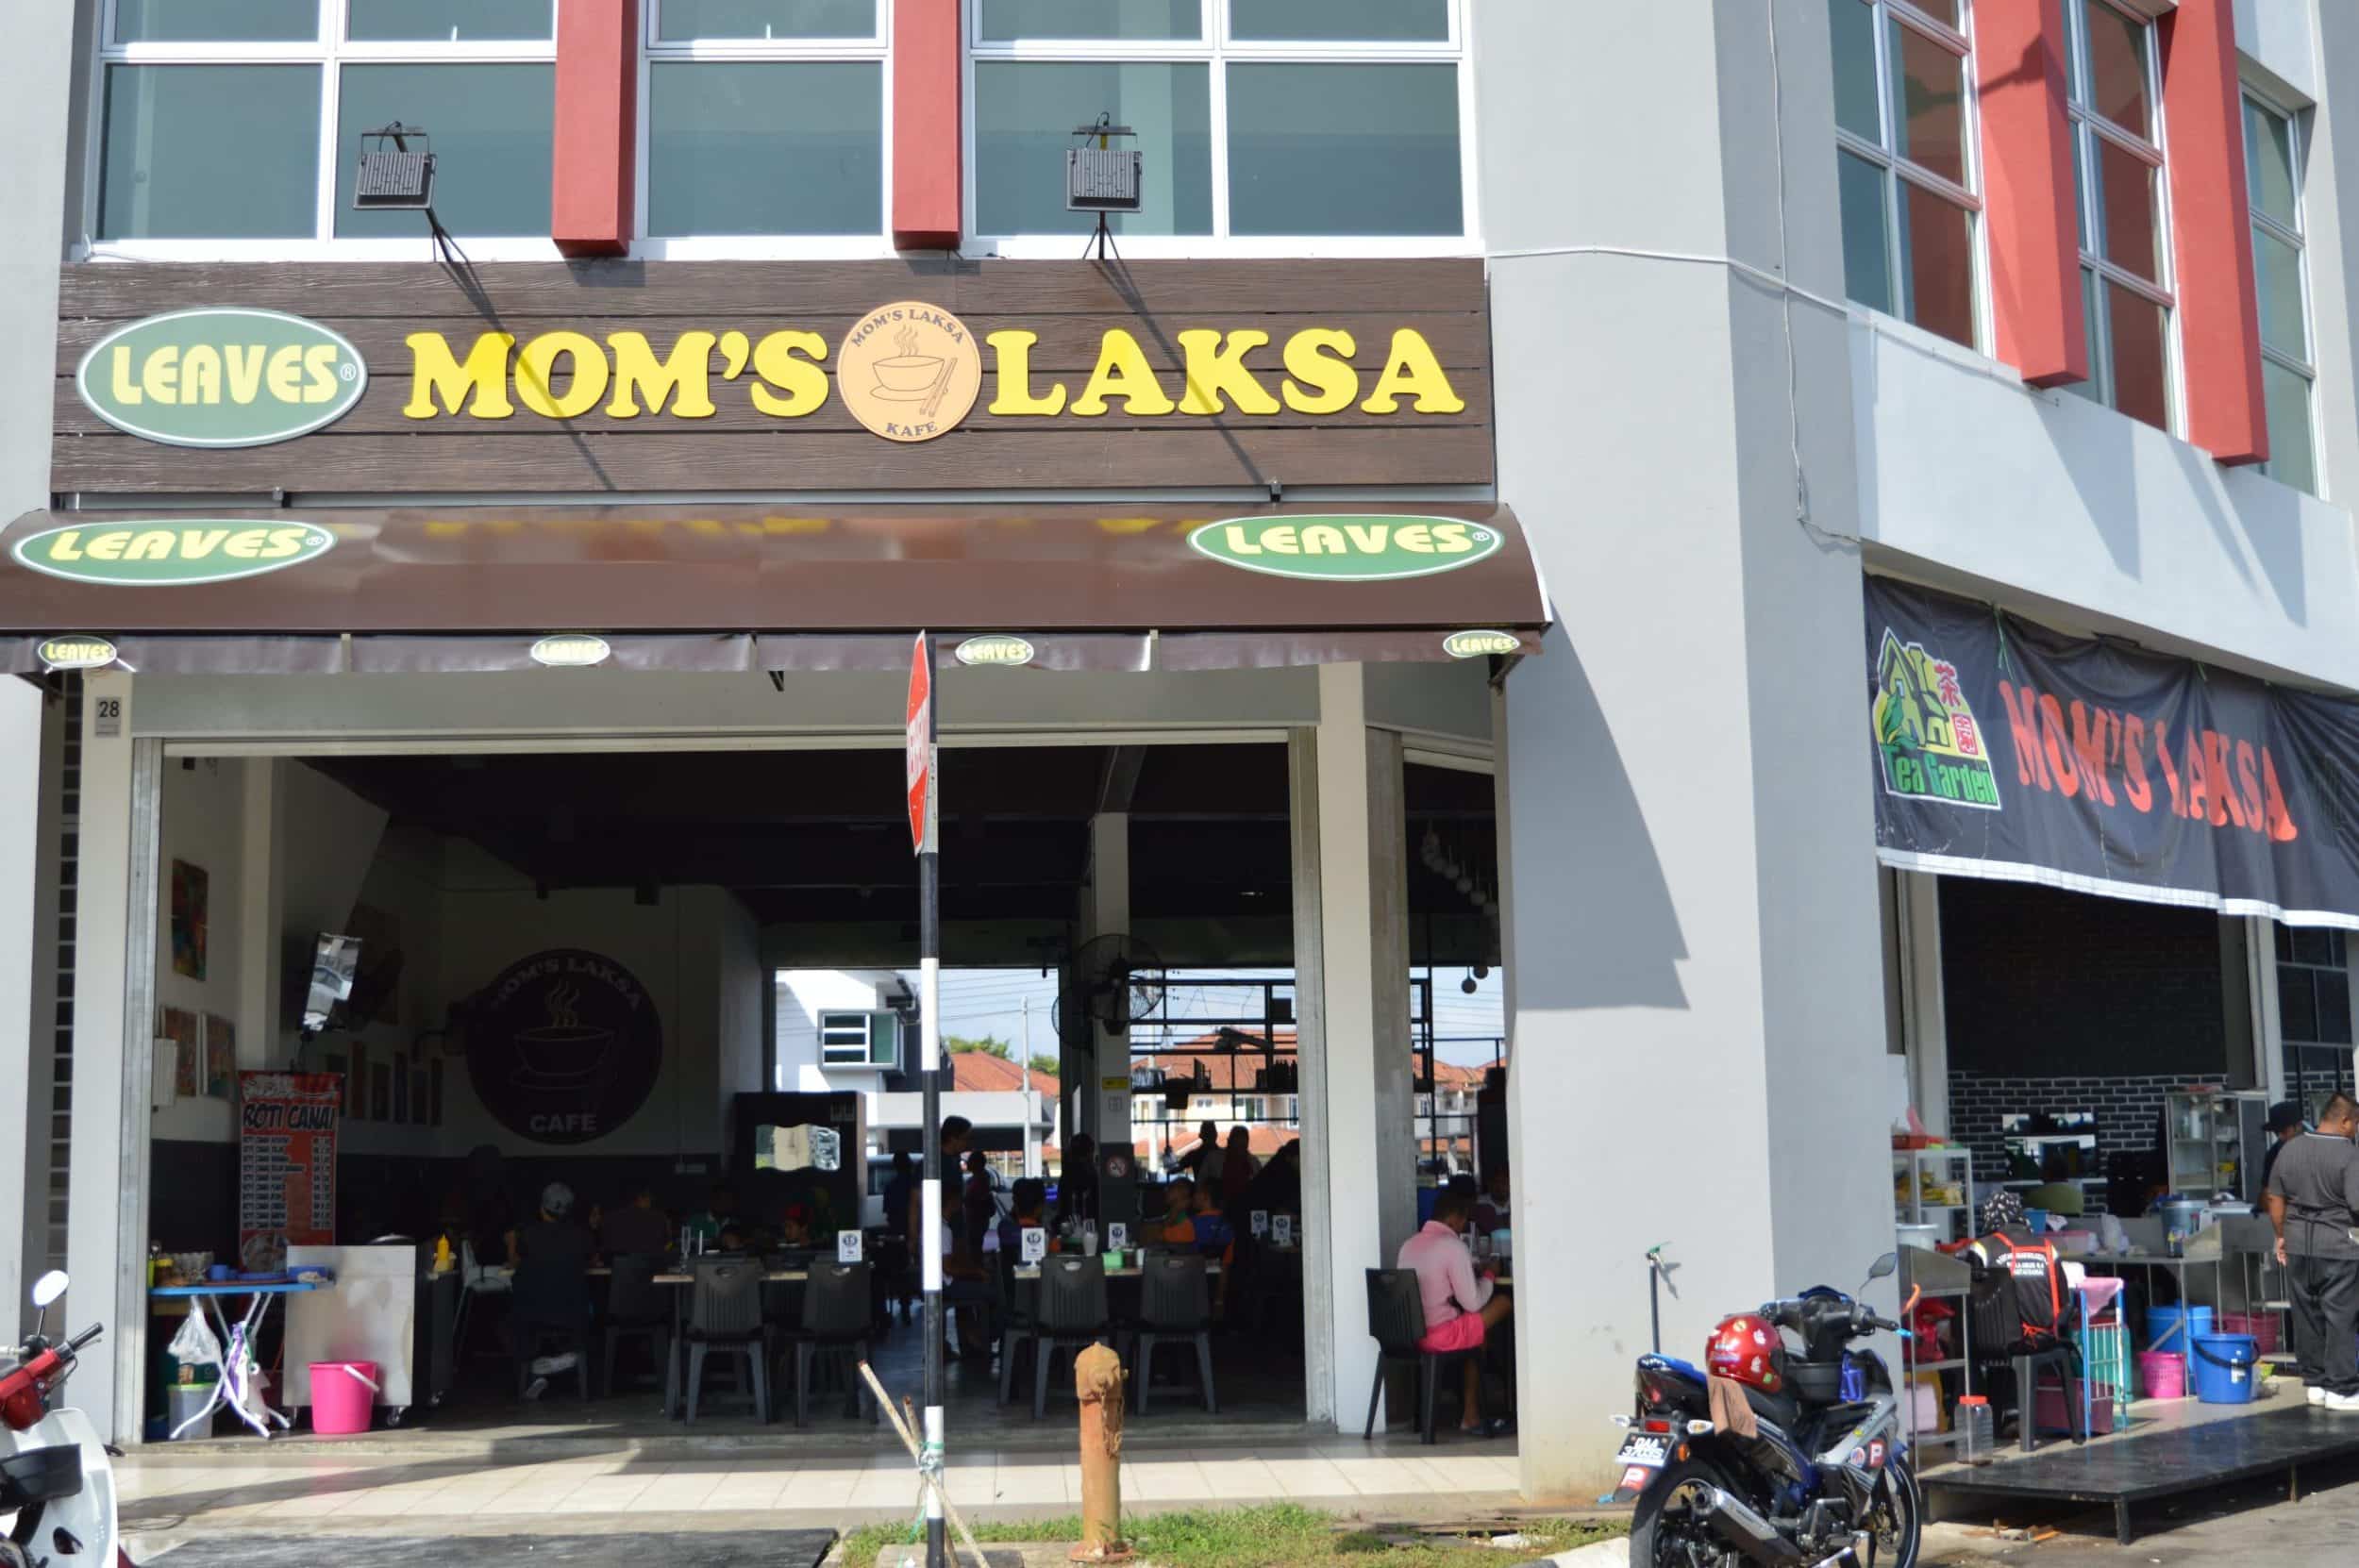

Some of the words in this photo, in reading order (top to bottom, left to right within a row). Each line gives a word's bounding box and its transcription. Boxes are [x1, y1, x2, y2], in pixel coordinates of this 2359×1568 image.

[851, 309, 904, 347] MOM'S
[909, 309, 965, 344] LAKSA
[402, 330, 829, 420] MOM'S
[986, 328, 1465, 417] LAKSA
[885, 421, 939, 437] KAFE
[45, 642, 110, 660] LEAVES
[1450, 638, 1513, 653] LEAVES
[99, 700, 120, 718] 28
[1999, 680, 2152, 813] MOM'S
[2156, 721, 2298, 842] LAKSA
[1881, 742, 1926, 793] Tea
[1924, 753, 1999, 804] Garden
[568, 957, 644, 1011] LAKSA
[243, 1104, 284, 1127] ROTI
[288, 1106, 335, 1129] CANAI
[528, 1113, 598, 1132] CAFE
[1870, 1443, 1883, 1465] P
[1621, 1466, 1646, 1487] P
